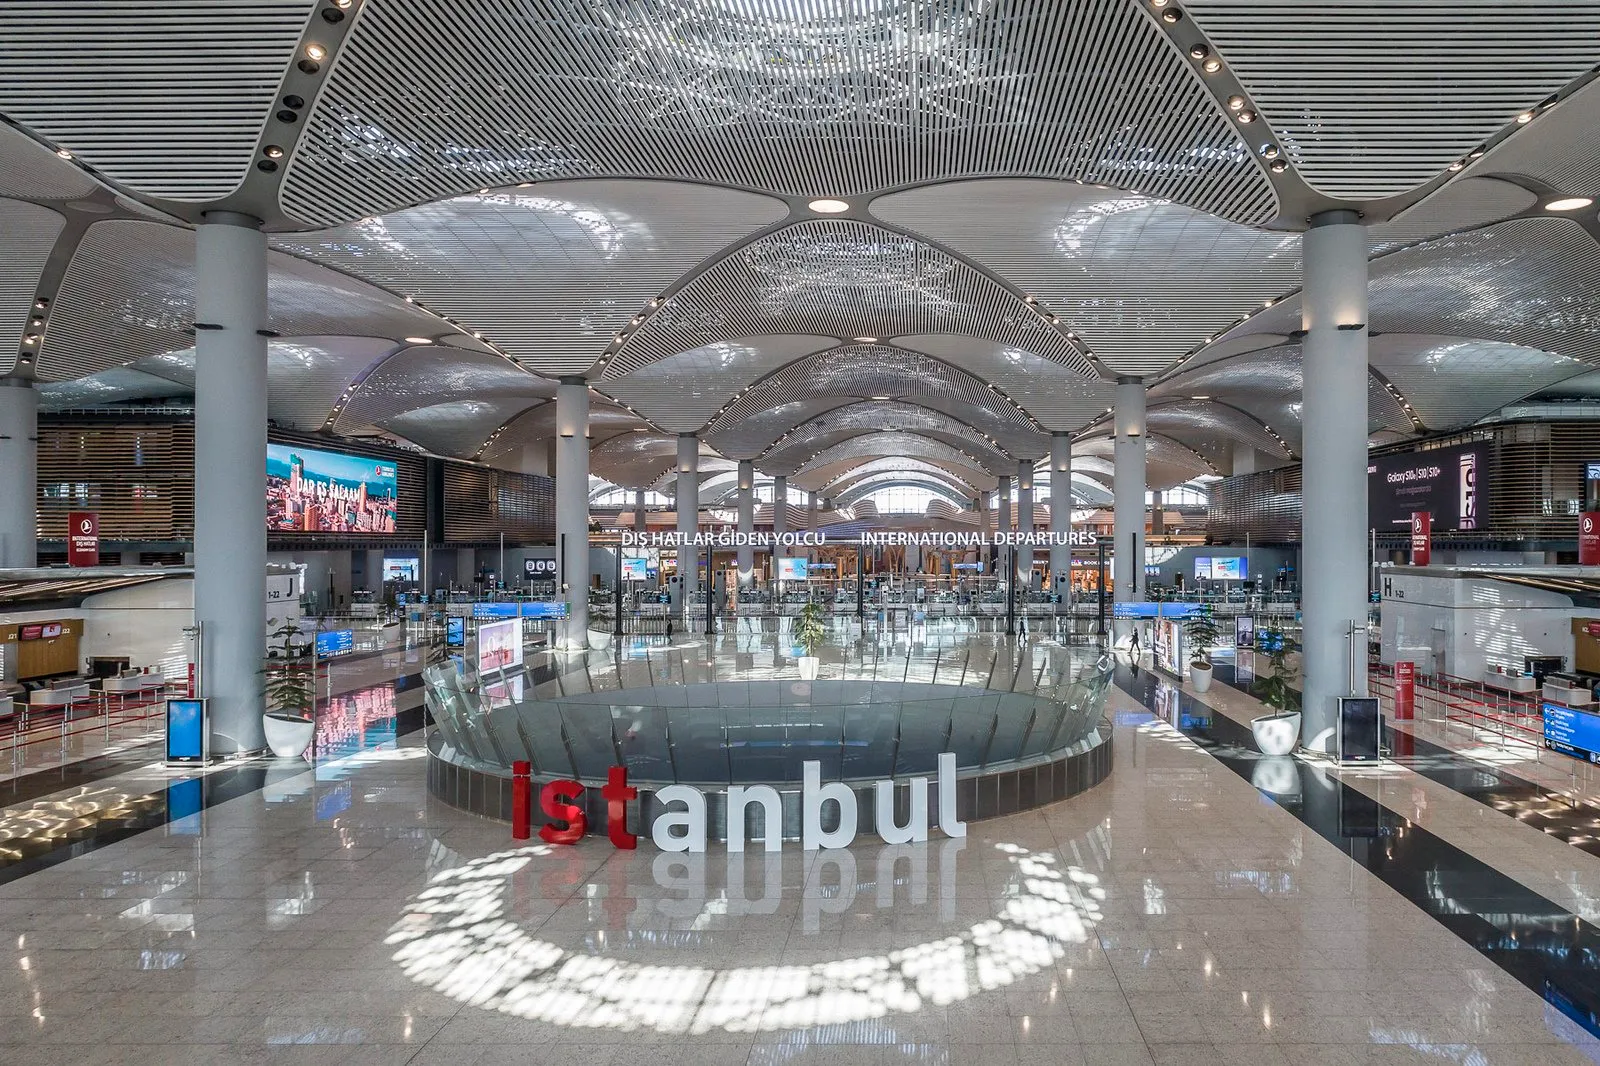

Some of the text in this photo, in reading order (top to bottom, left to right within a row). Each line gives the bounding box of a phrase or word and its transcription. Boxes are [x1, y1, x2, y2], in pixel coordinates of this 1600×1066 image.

[1387, 472, 1405, 483] Galaxy
[297, 477, 361, 501] DAR ES SALAAM
[621, 528, 826, 549] DIŞ HATLAR GİDEN YOLCU
[861, 531, 1097, 546] INTERNATIONAL DEPARTURES
[268, 591, 280, 599] 1-22
[286, 578, 293, 597] J
[1384, 577, 1392, 597] H
[512, 752, 967, 853] istanbul
